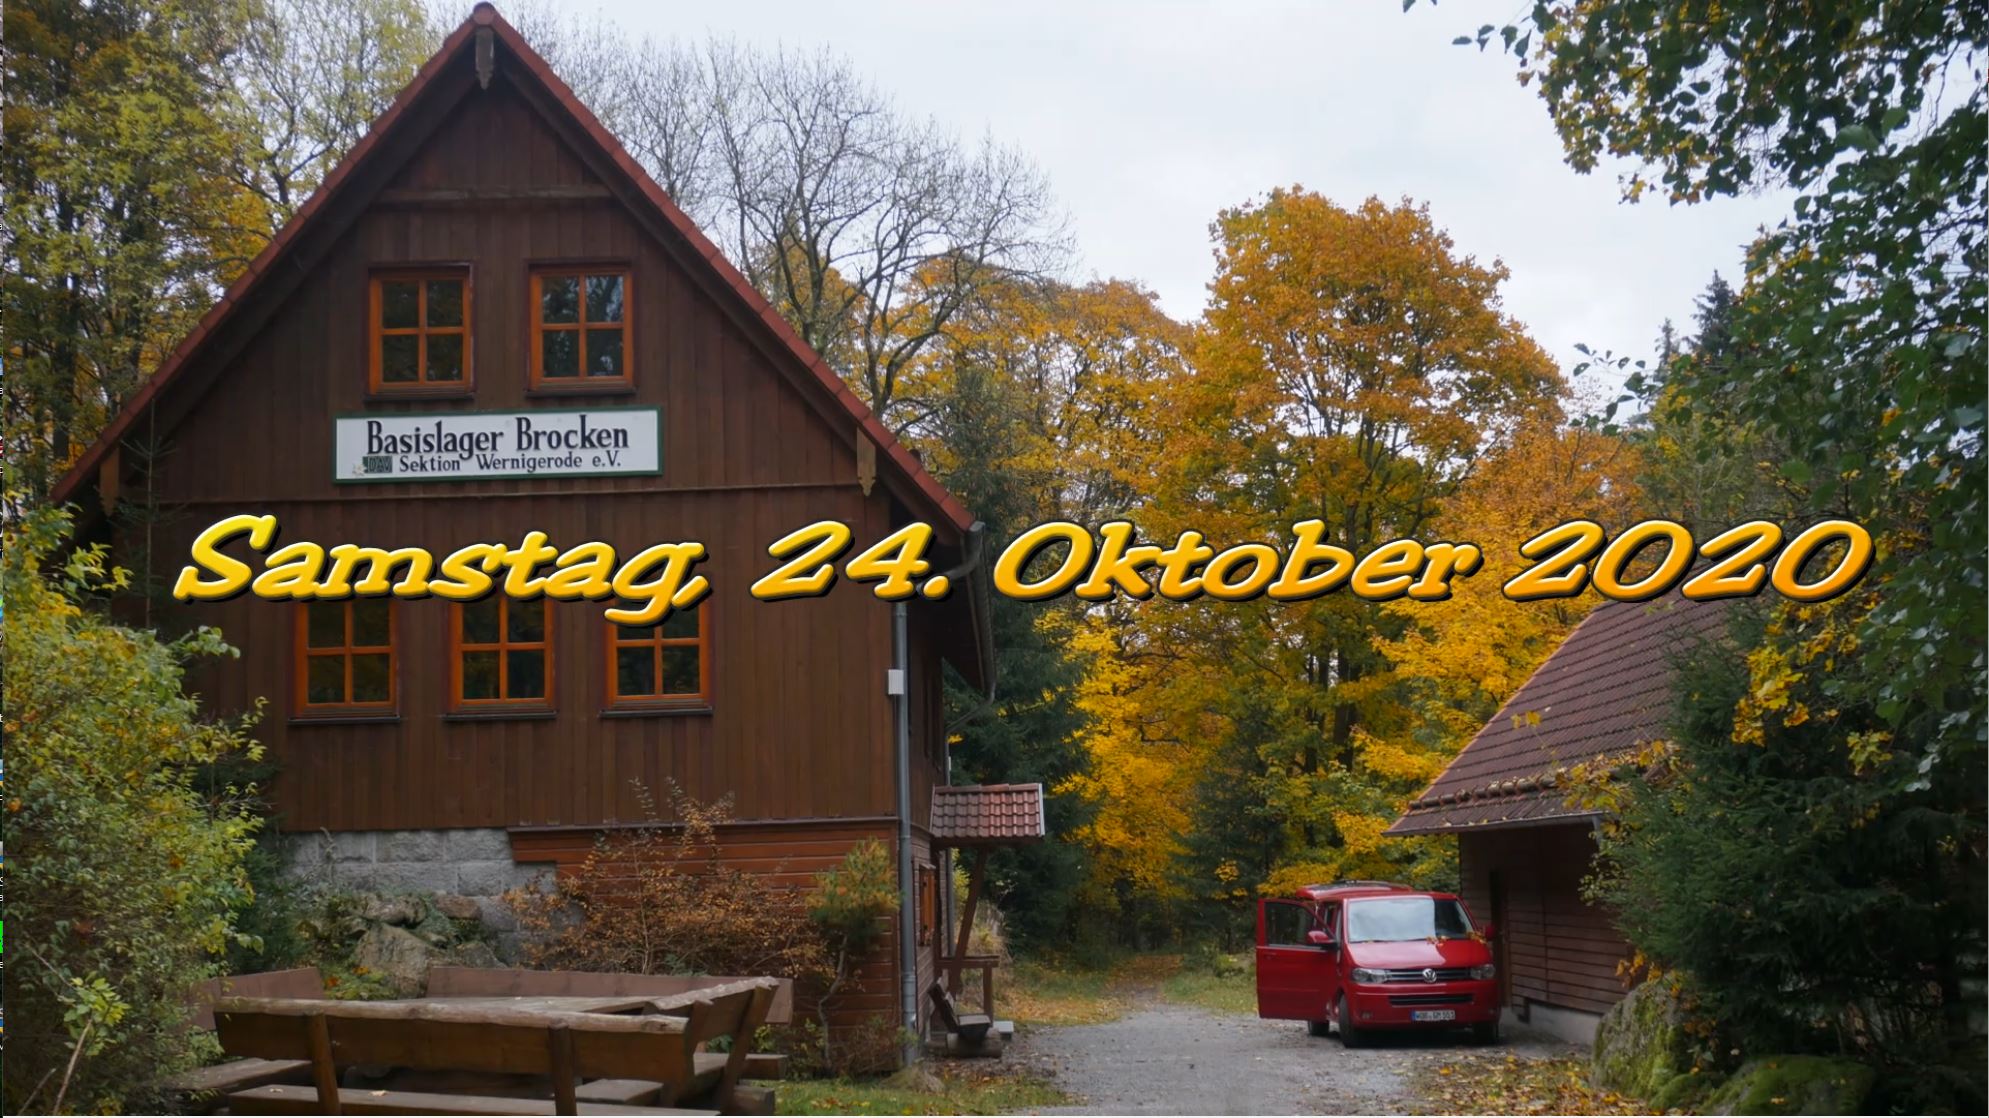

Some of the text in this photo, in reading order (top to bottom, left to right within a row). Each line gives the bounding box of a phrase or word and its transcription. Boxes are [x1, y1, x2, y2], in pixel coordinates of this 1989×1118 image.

[366, 414, 629, 460] Basislager Brocken
[399, 449, 622, 474] Sektion Wernigerode e.V.
